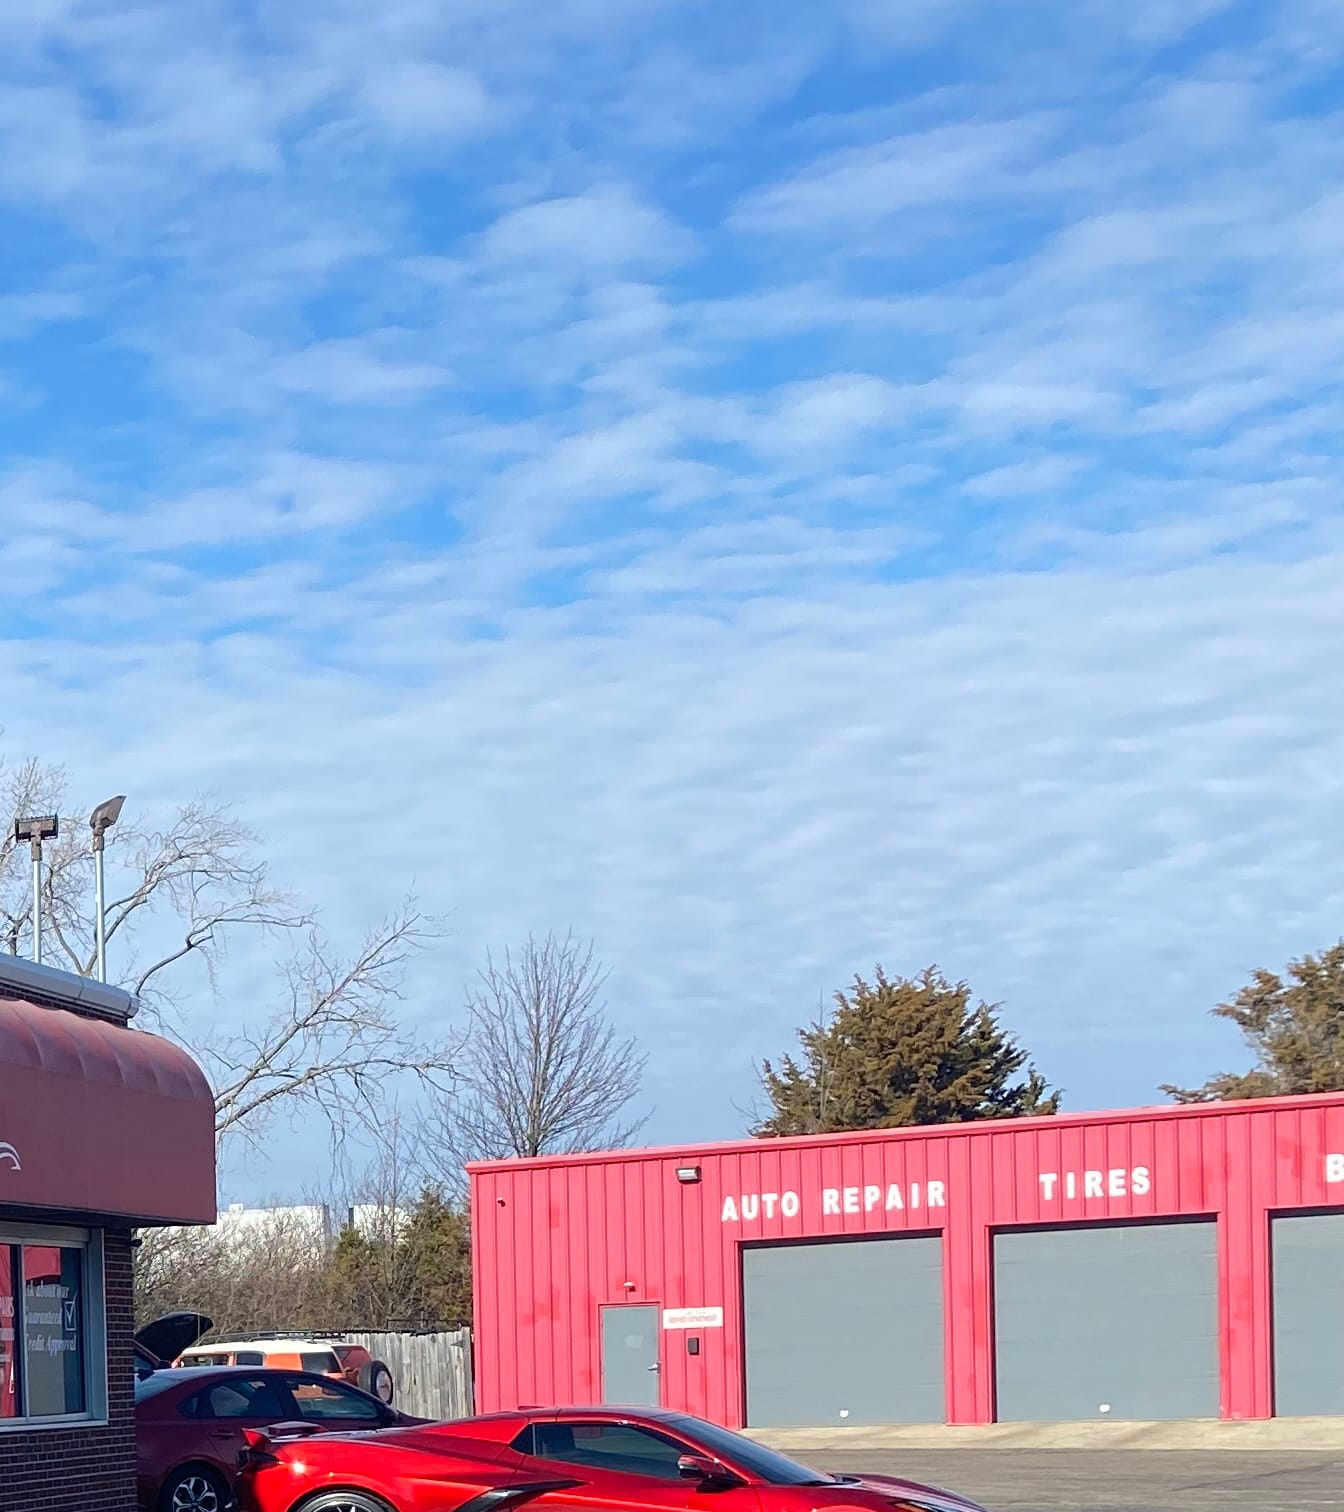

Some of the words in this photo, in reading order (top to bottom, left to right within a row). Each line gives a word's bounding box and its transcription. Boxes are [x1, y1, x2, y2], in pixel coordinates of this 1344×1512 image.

[721, 1191, 799, 1221] AUTO
[822, 1181, 945, 1215] REPAIR
[1039, 1166, 1150, 1200] TIRES
